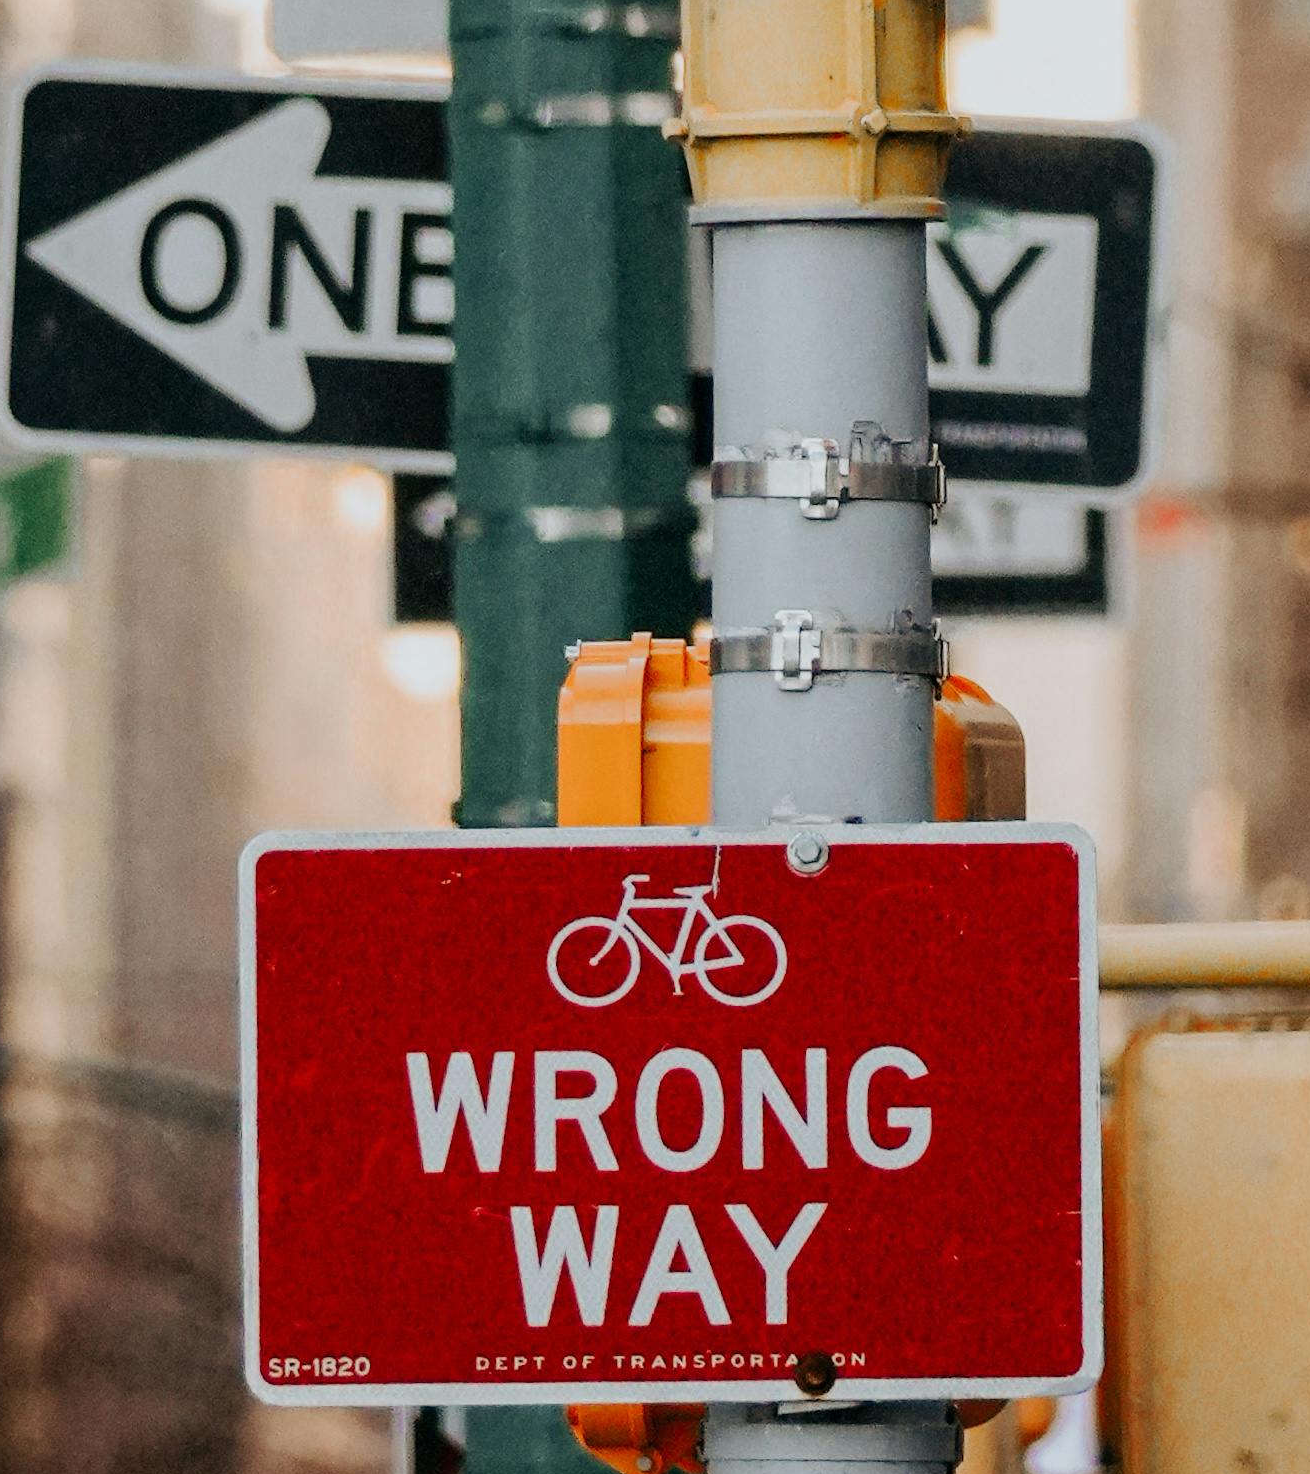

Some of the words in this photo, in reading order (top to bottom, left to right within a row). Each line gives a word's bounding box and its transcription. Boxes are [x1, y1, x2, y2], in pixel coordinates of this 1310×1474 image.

[138, 197, 453, 337] ONE
[406, 1046, 932, 1173] WRONG
[510, 1202, 828, 1327] WAY
[268, 1356, 371, 1378] SR-1820
[475, 1355, 546, 1372] DEPT
[562, 1355, 596, 1370] OF
[613, 1352, 867, 1370] TRANSPORTAON
